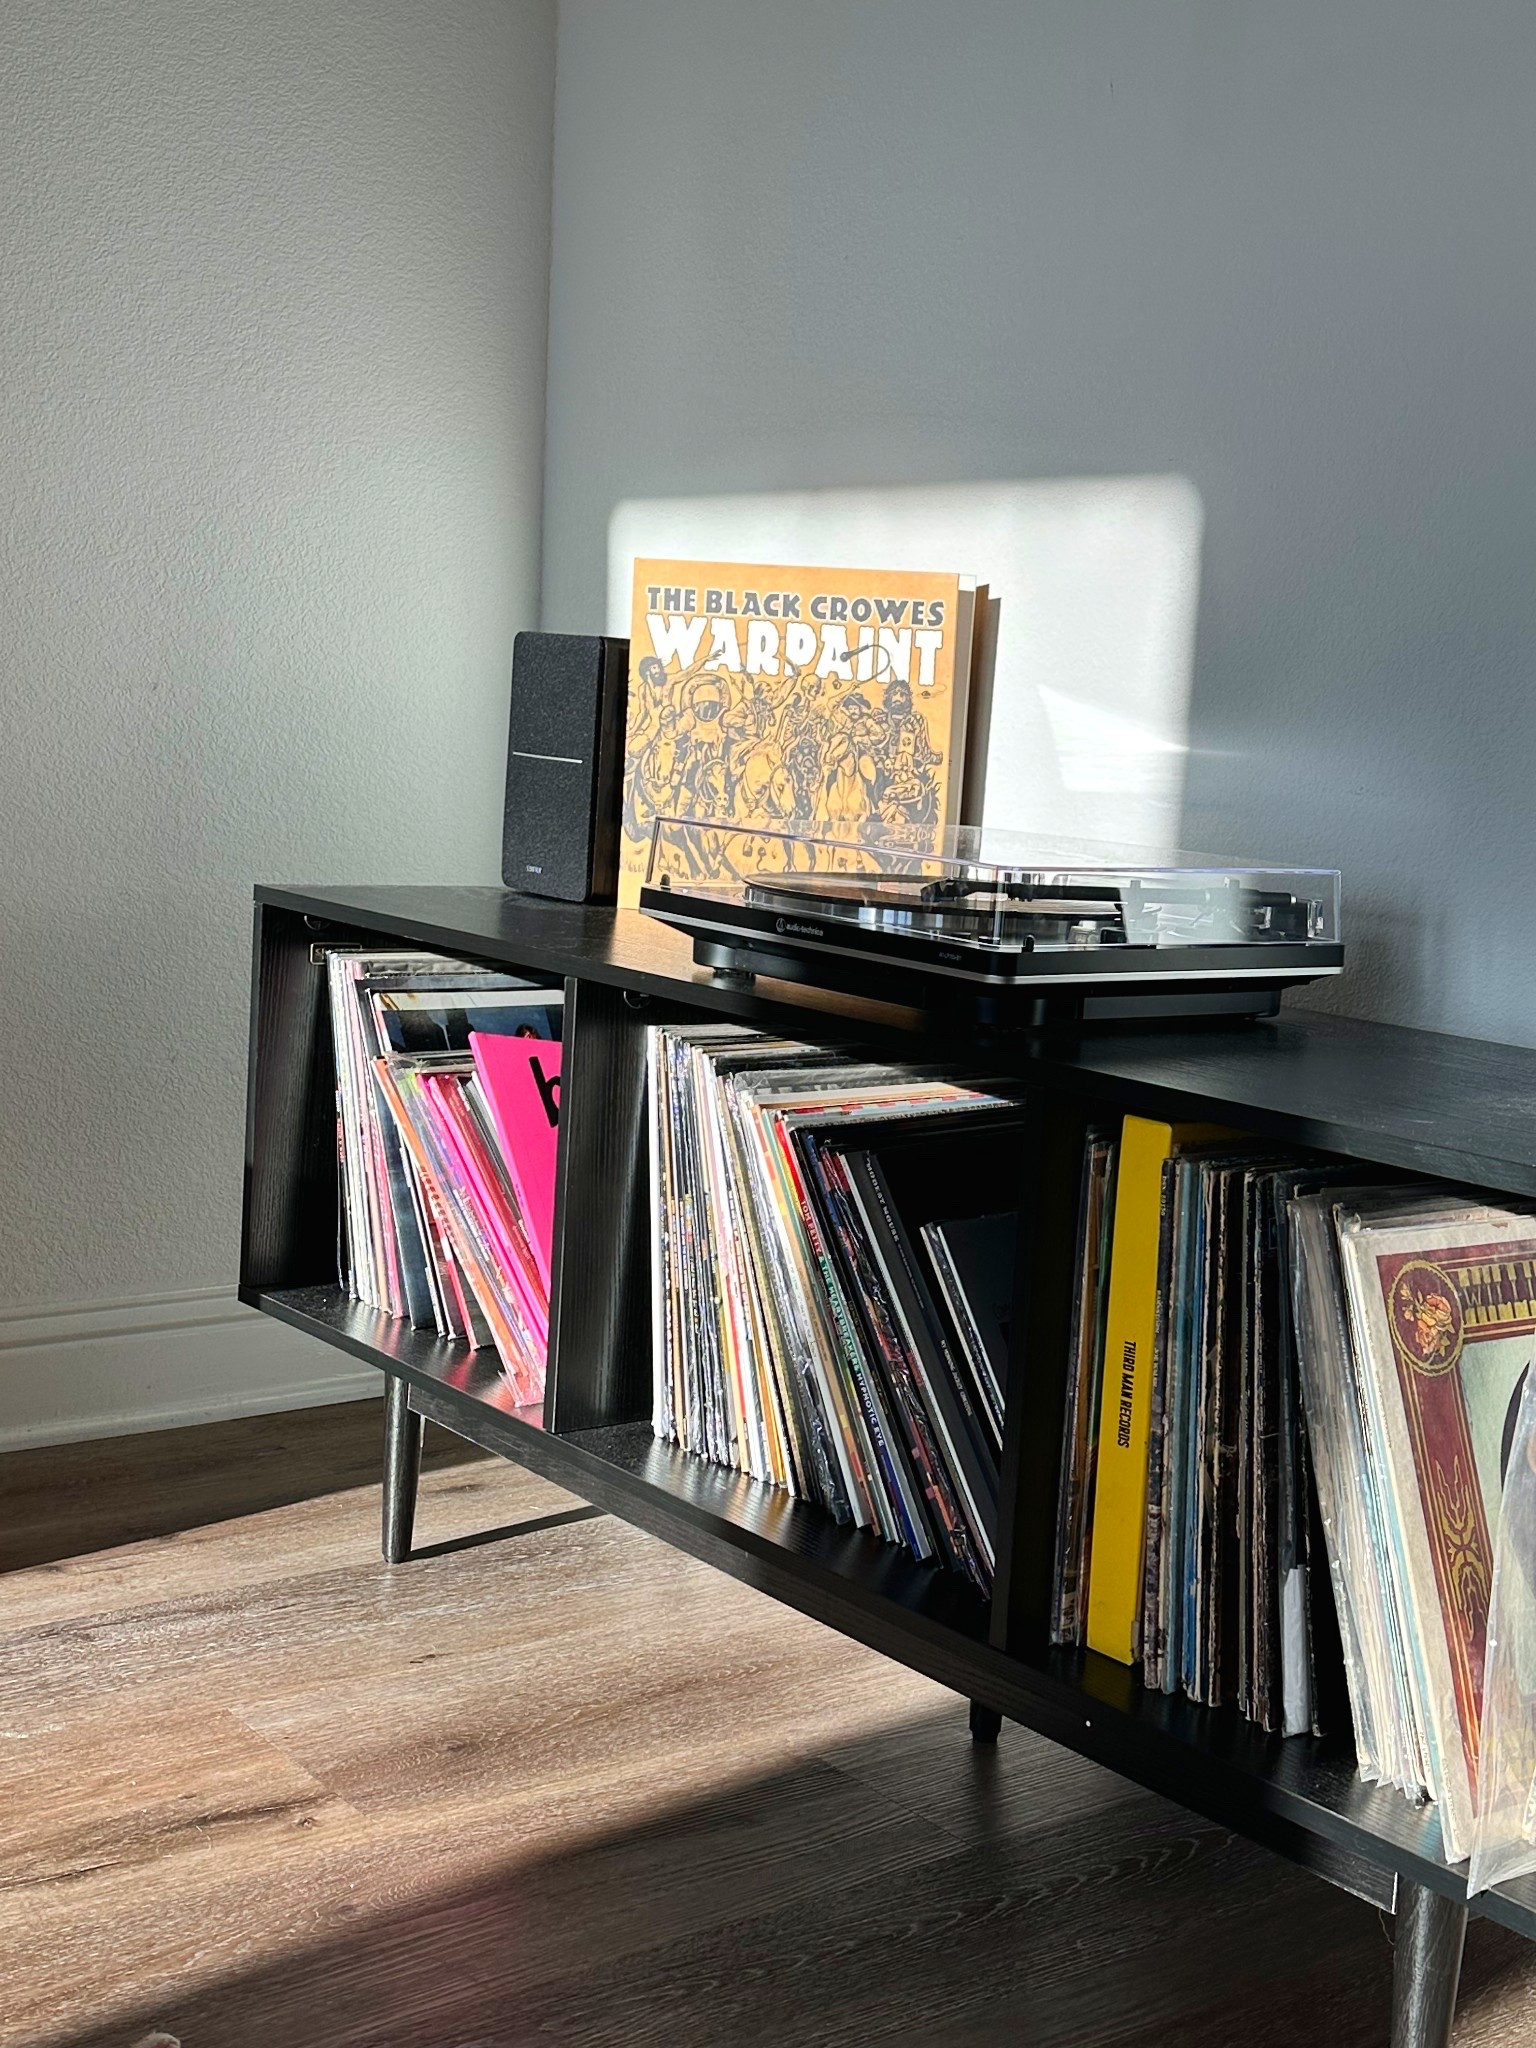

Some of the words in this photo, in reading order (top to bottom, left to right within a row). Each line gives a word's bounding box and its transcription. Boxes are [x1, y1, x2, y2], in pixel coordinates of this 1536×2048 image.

[647, 586, 697, 613] THE
[705, 589, 801, 619] BLACK
[810, 596, 946, 627] CROWES
[646, 614, 944, 687] WARPAINT
[800, 1200, 813, 1220] TOM
[806, 1220, 823, 1254] PETTY
[822, 1264, 834, 1284] THE
[828, 1284, 862, 1372] HEARTBREAKERS
[1122, 1341, 1137, 1373] THIRD
[856, 1371, 879, 1426] HYPNOTIC
[1120, 1372, 1135, 1400] MAN
[873, 1424, 886, 1448] EYE
[1117, 1399, 1133, 1449] RECORDS
